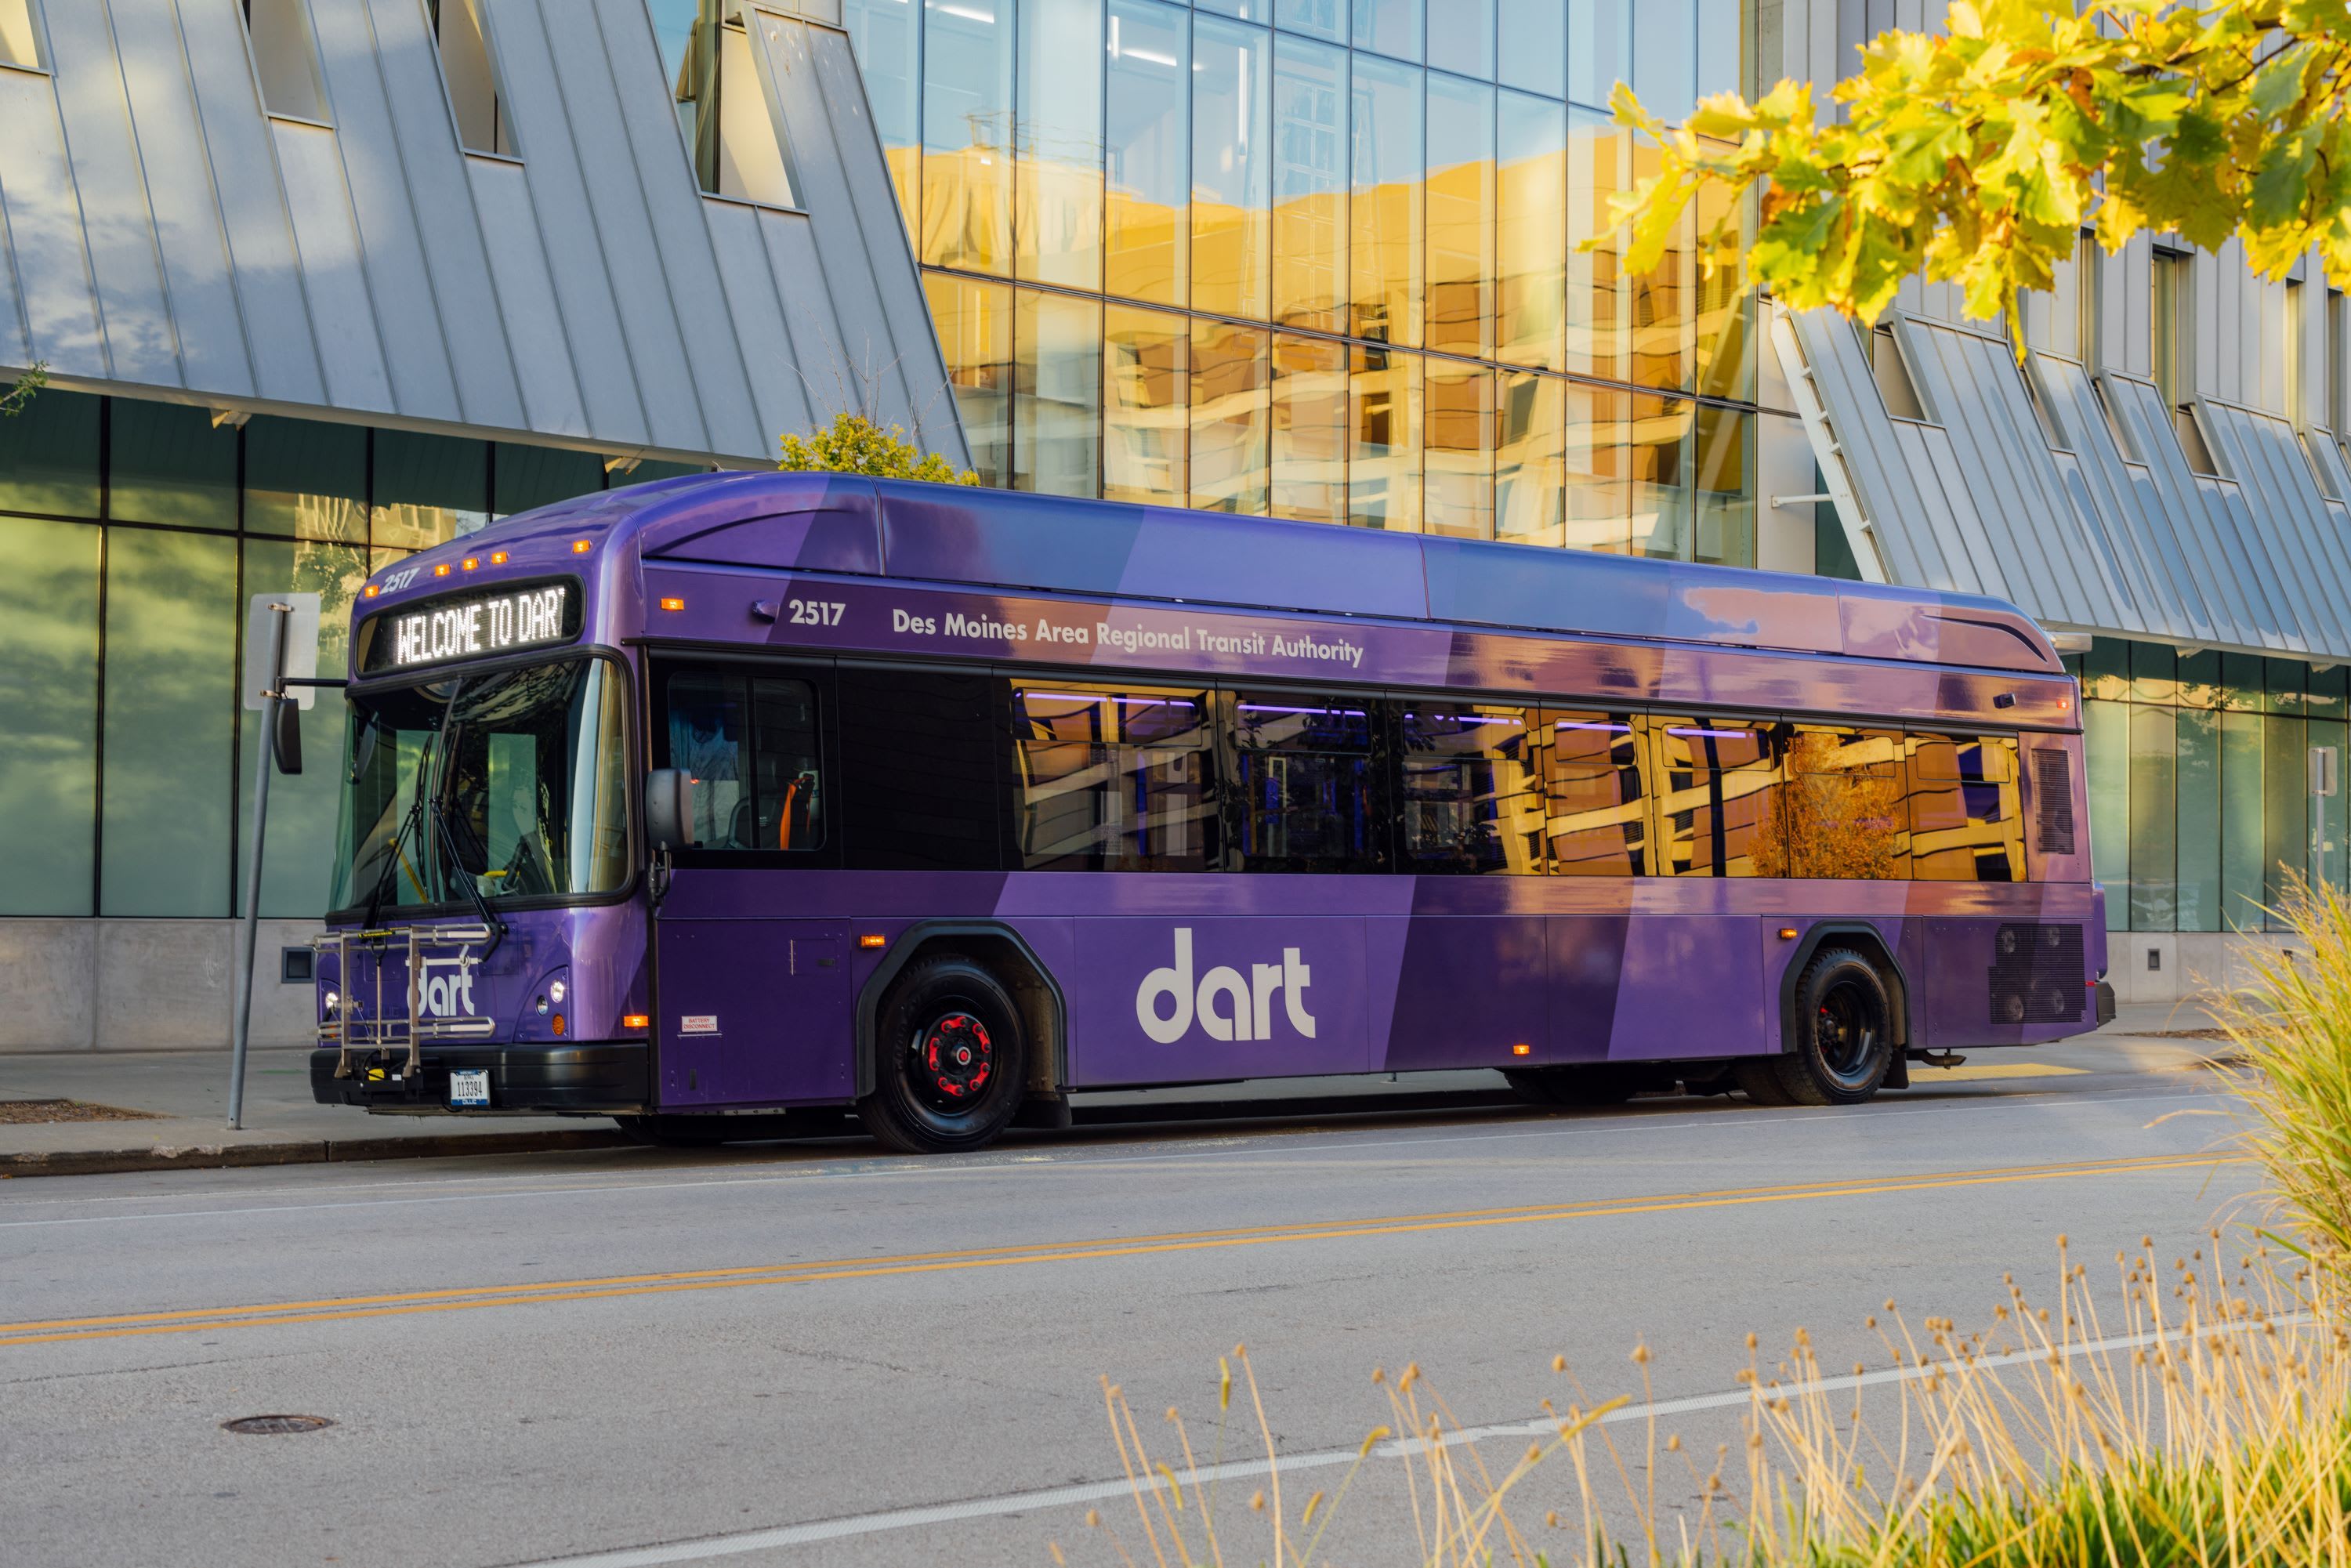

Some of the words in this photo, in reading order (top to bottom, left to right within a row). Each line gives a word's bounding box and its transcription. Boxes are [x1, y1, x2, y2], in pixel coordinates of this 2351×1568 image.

[379, 567, 421, 595] 2517
[397, 604, 482, 664] WELCOME
[488, 598, 512, 648] TO
[518, 587, 565, 643] DAR
[788, 599, 846, 626] 2517
[893, 608, 936, 636] Des
[944, 612, 1028, 641] Moines
[1034, 618, 1089, 644] Area
[1096, 622, 1190, 654] Regional
[1196, 629, 1266, 655] Transit
[1271, 634, 1364, 668] Authority
[406, 955, 475, 1017] dart
[1136, 927, 1317, 1044] dart
[458, 1081, 483, 1097] 113394
